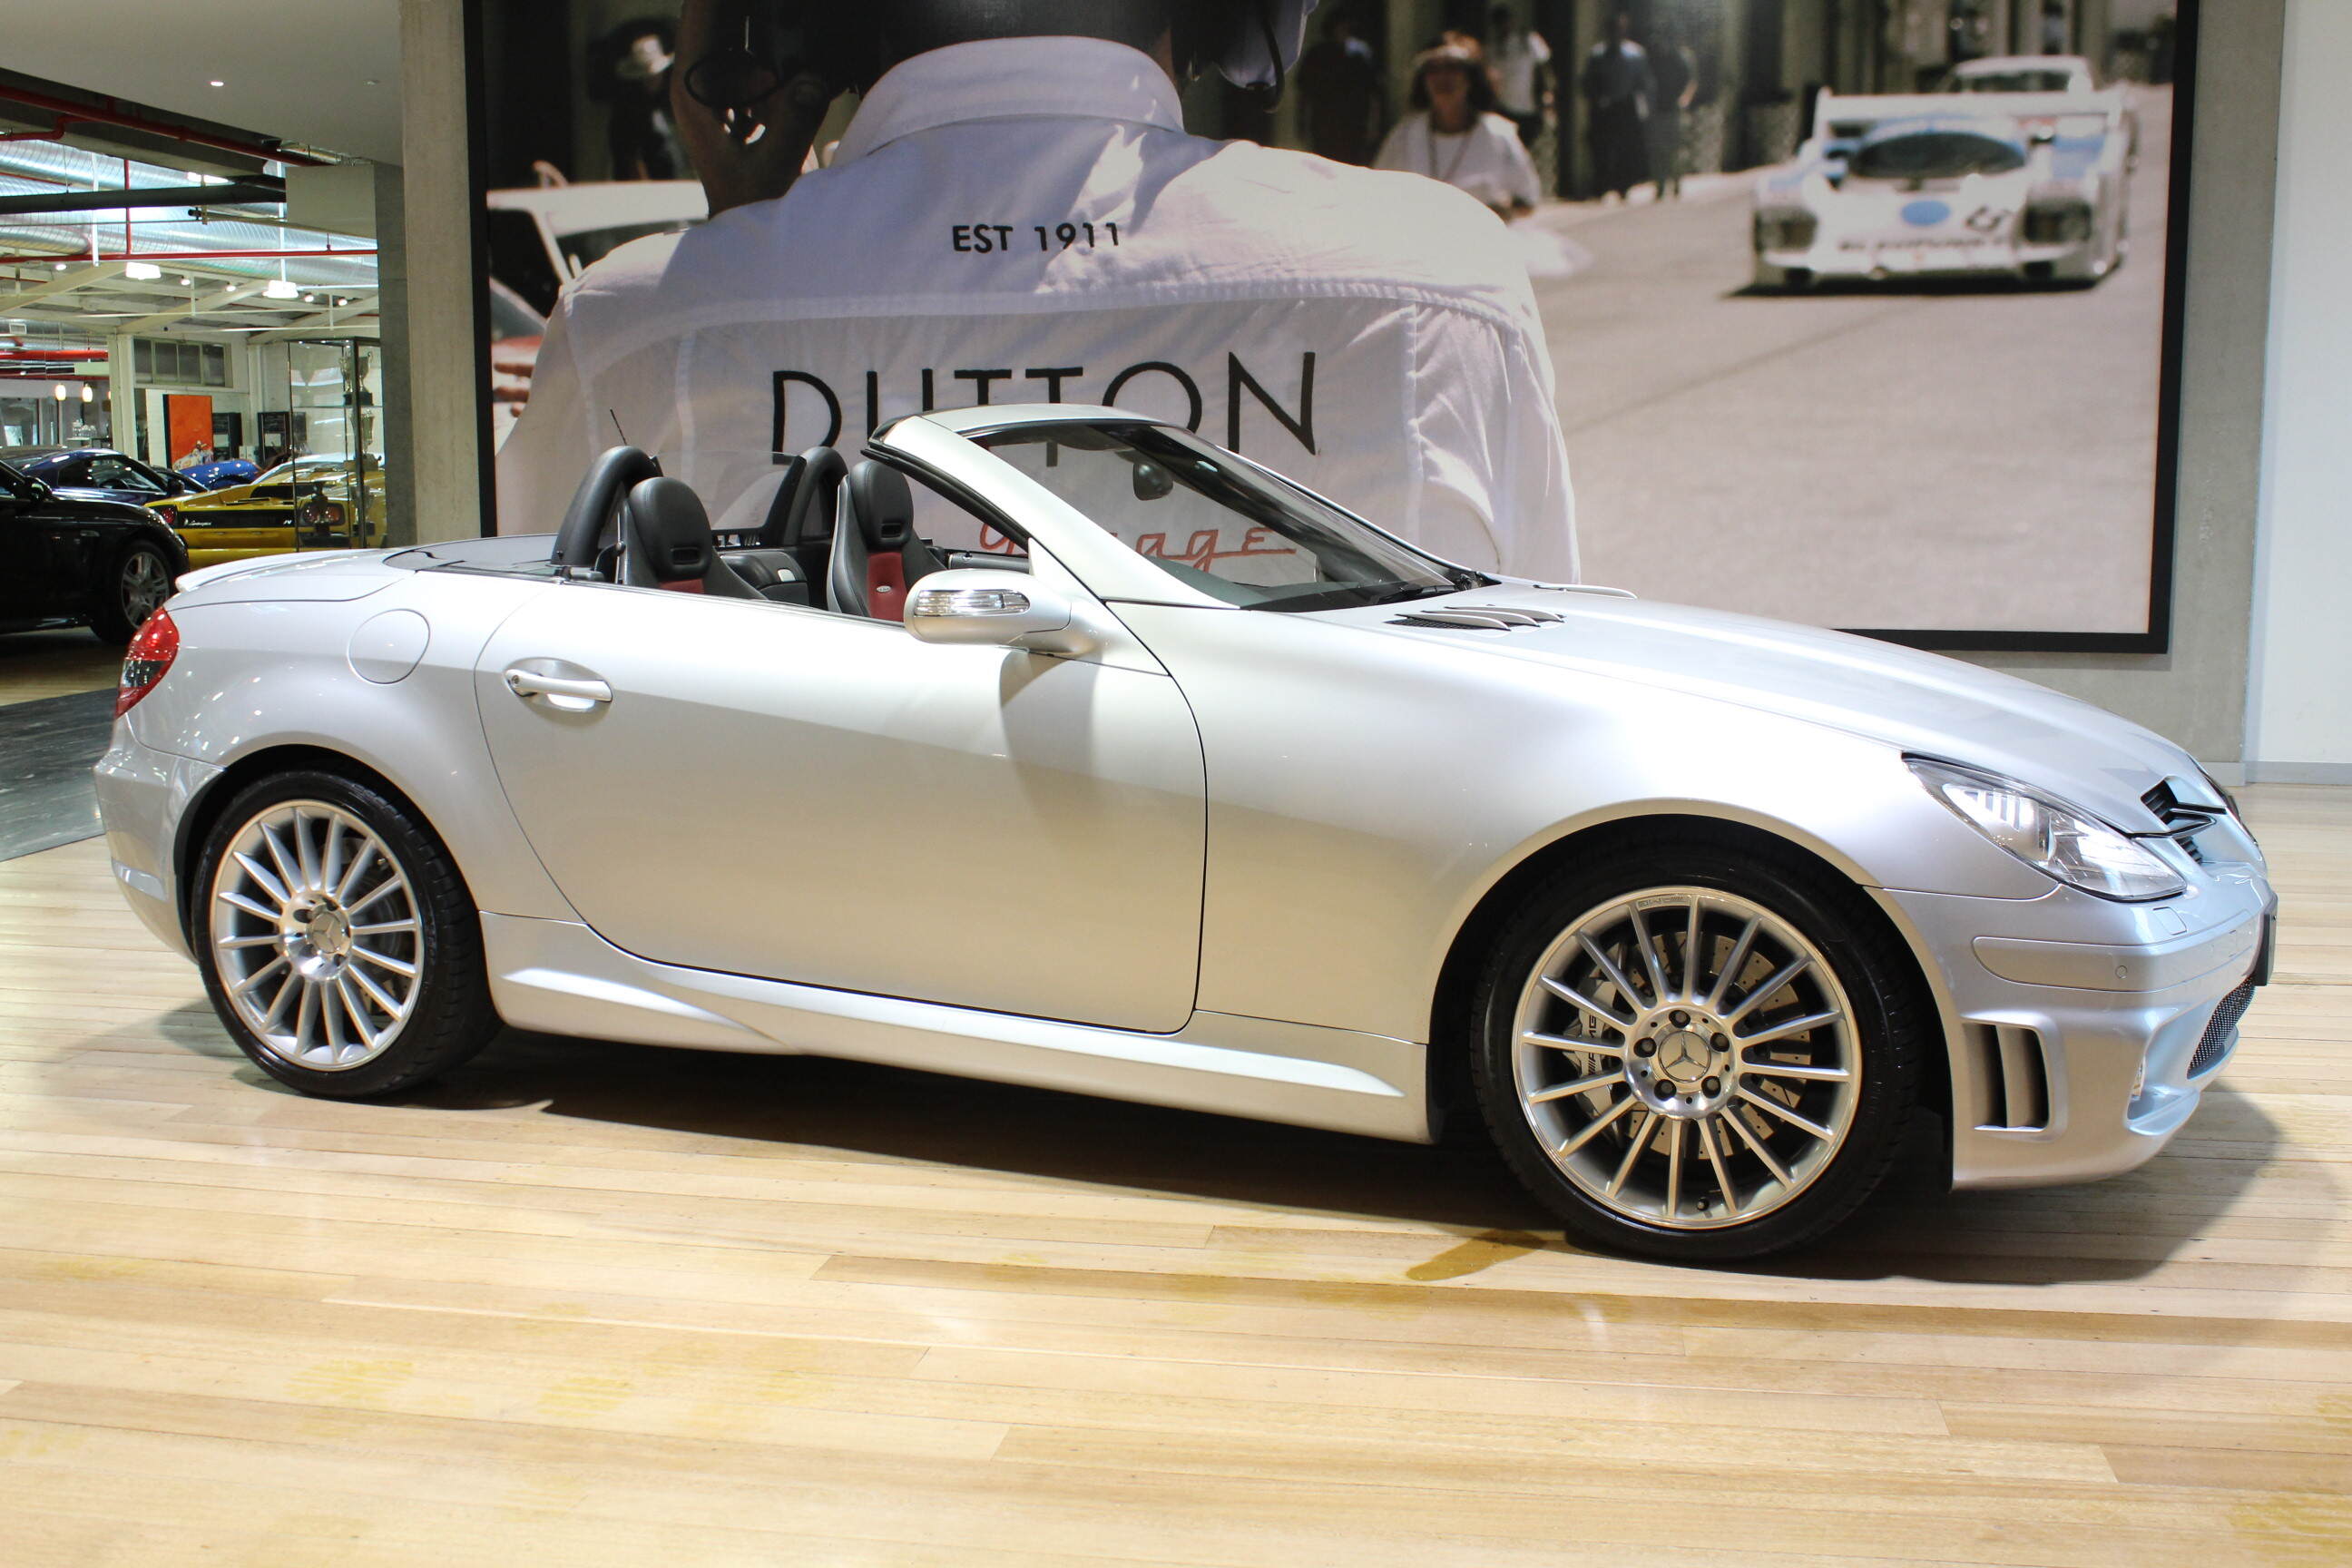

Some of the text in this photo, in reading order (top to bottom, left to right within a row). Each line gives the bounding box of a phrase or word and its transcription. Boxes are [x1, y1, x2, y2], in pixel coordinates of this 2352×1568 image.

[952, 221, 1119, 254] EST 1911
[980, 523, 1297, 573] age
